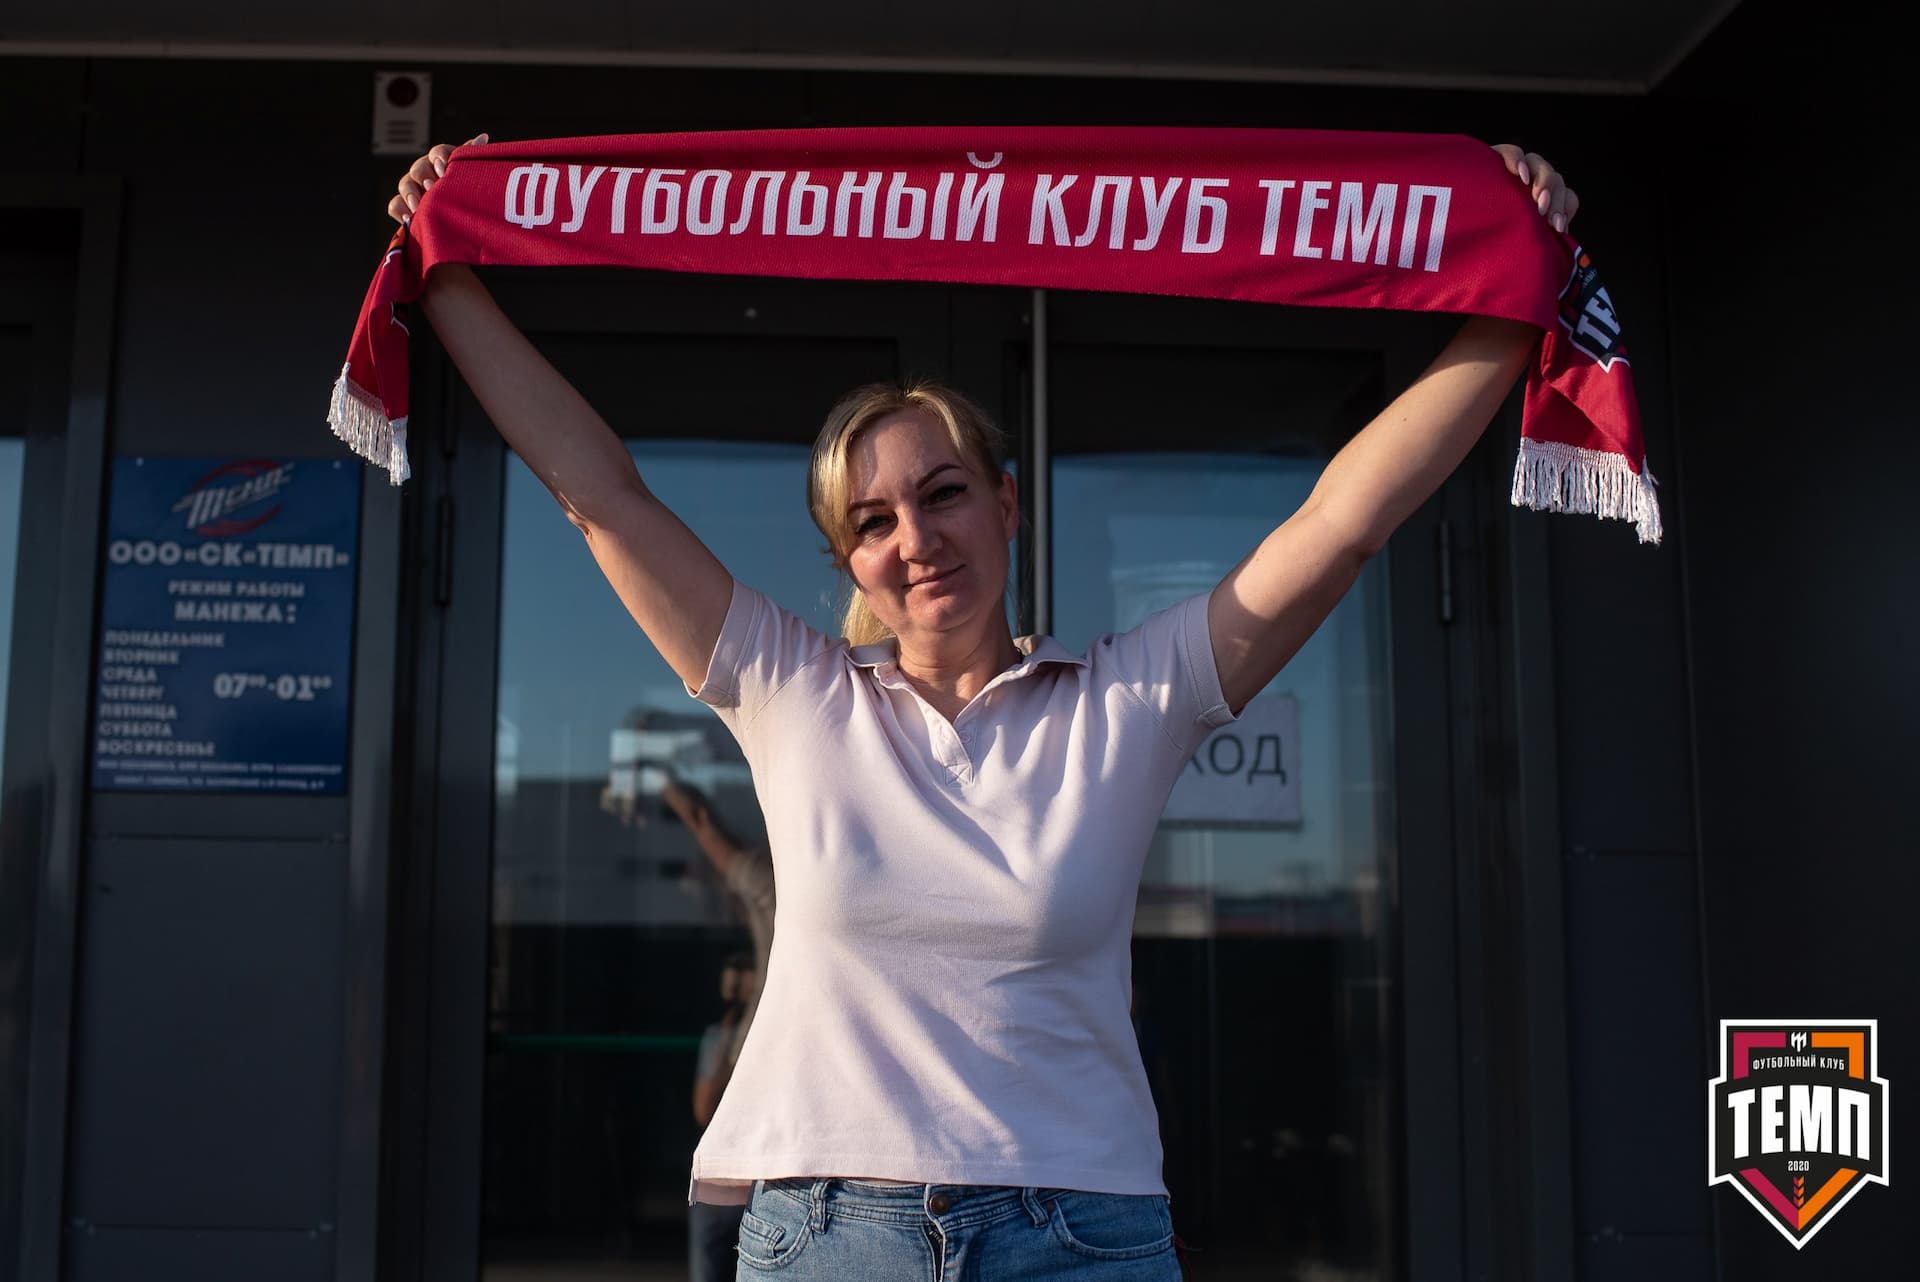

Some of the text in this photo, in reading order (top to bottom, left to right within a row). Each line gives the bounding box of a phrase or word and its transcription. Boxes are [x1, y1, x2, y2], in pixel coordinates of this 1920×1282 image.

[504, 152, 1453, 273] ФУТБОЛЬНЫЙ КЛУБ ТЕМП
[168, 579, 306, 598] РЕЖИМ РАБОТЫ
[101, 666, 158, 683] СРЕДА
